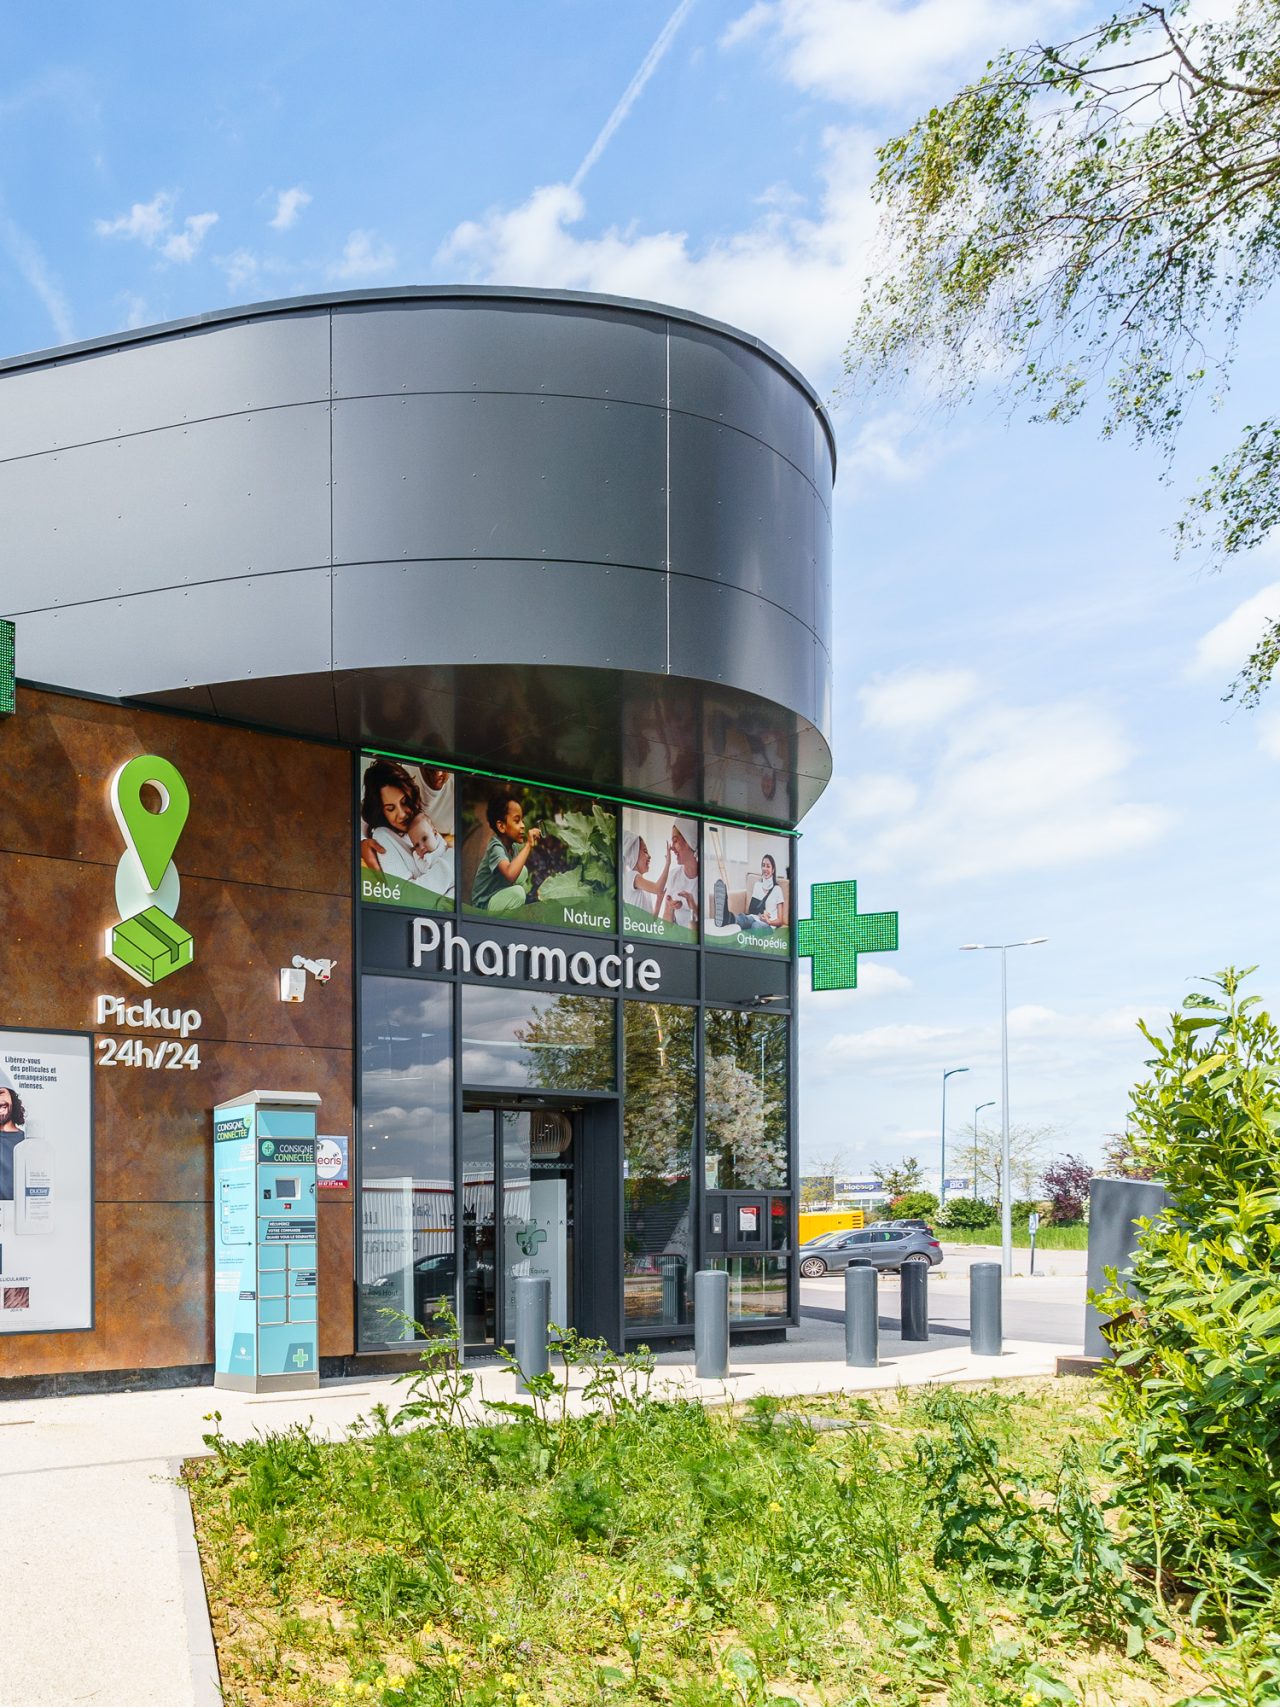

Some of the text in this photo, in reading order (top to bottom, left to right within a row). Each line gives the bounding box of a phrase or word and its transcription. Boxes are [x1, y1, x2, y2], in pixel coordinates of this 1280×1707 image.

[362, 881, 401, 900] Bébé
[564, 908, 611, 928] Nature
[624, 916, 665, 935] Beauté
[737, 932, 788, 950] Orthopédie
[412, 917, 662, 992] Pharmacie
[97, 994, 202, 1038] Pickup
[98, 1038, 202, 1070] 24h/24
[21, 1065, 50, 1074] pellicules
[217, 1121, 244, 1132] CONSIGNE
[217, 1128, 248, 1141] CONNECTÉE
[273, 1152, 314, 1162] CONNECTÉE
[279, 1144, 314, 1154] CONSIGNE
[317, 1157, 342, 1165] eoris
